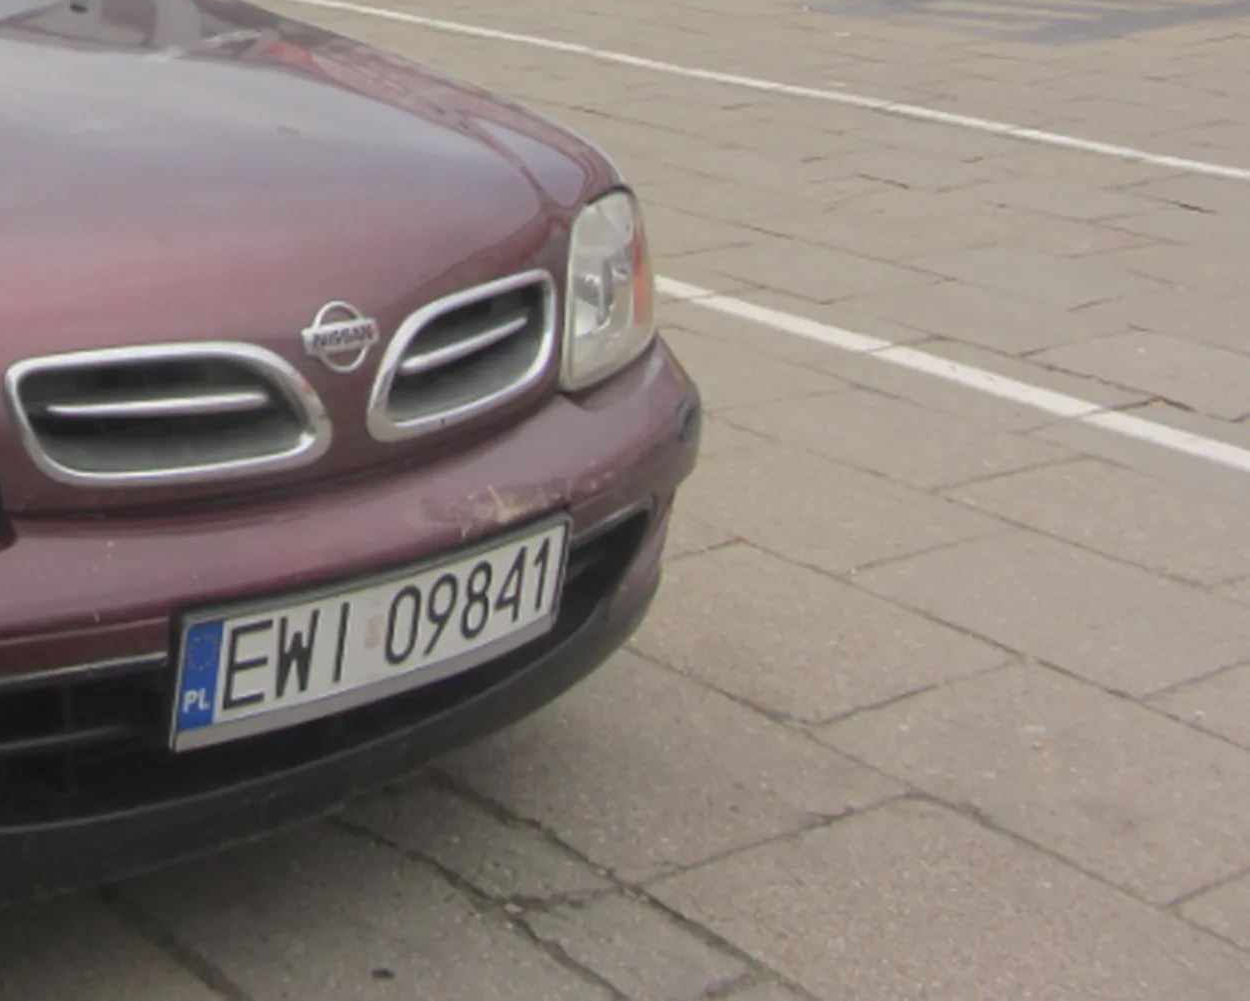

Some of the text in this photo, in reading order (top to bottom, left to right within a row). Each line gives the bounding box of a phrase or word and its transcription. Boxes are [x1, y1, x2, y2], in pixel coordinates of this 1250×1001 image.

[222, 537, 550, 711] EWI 09841
[182, 688, 211, 713] PL
